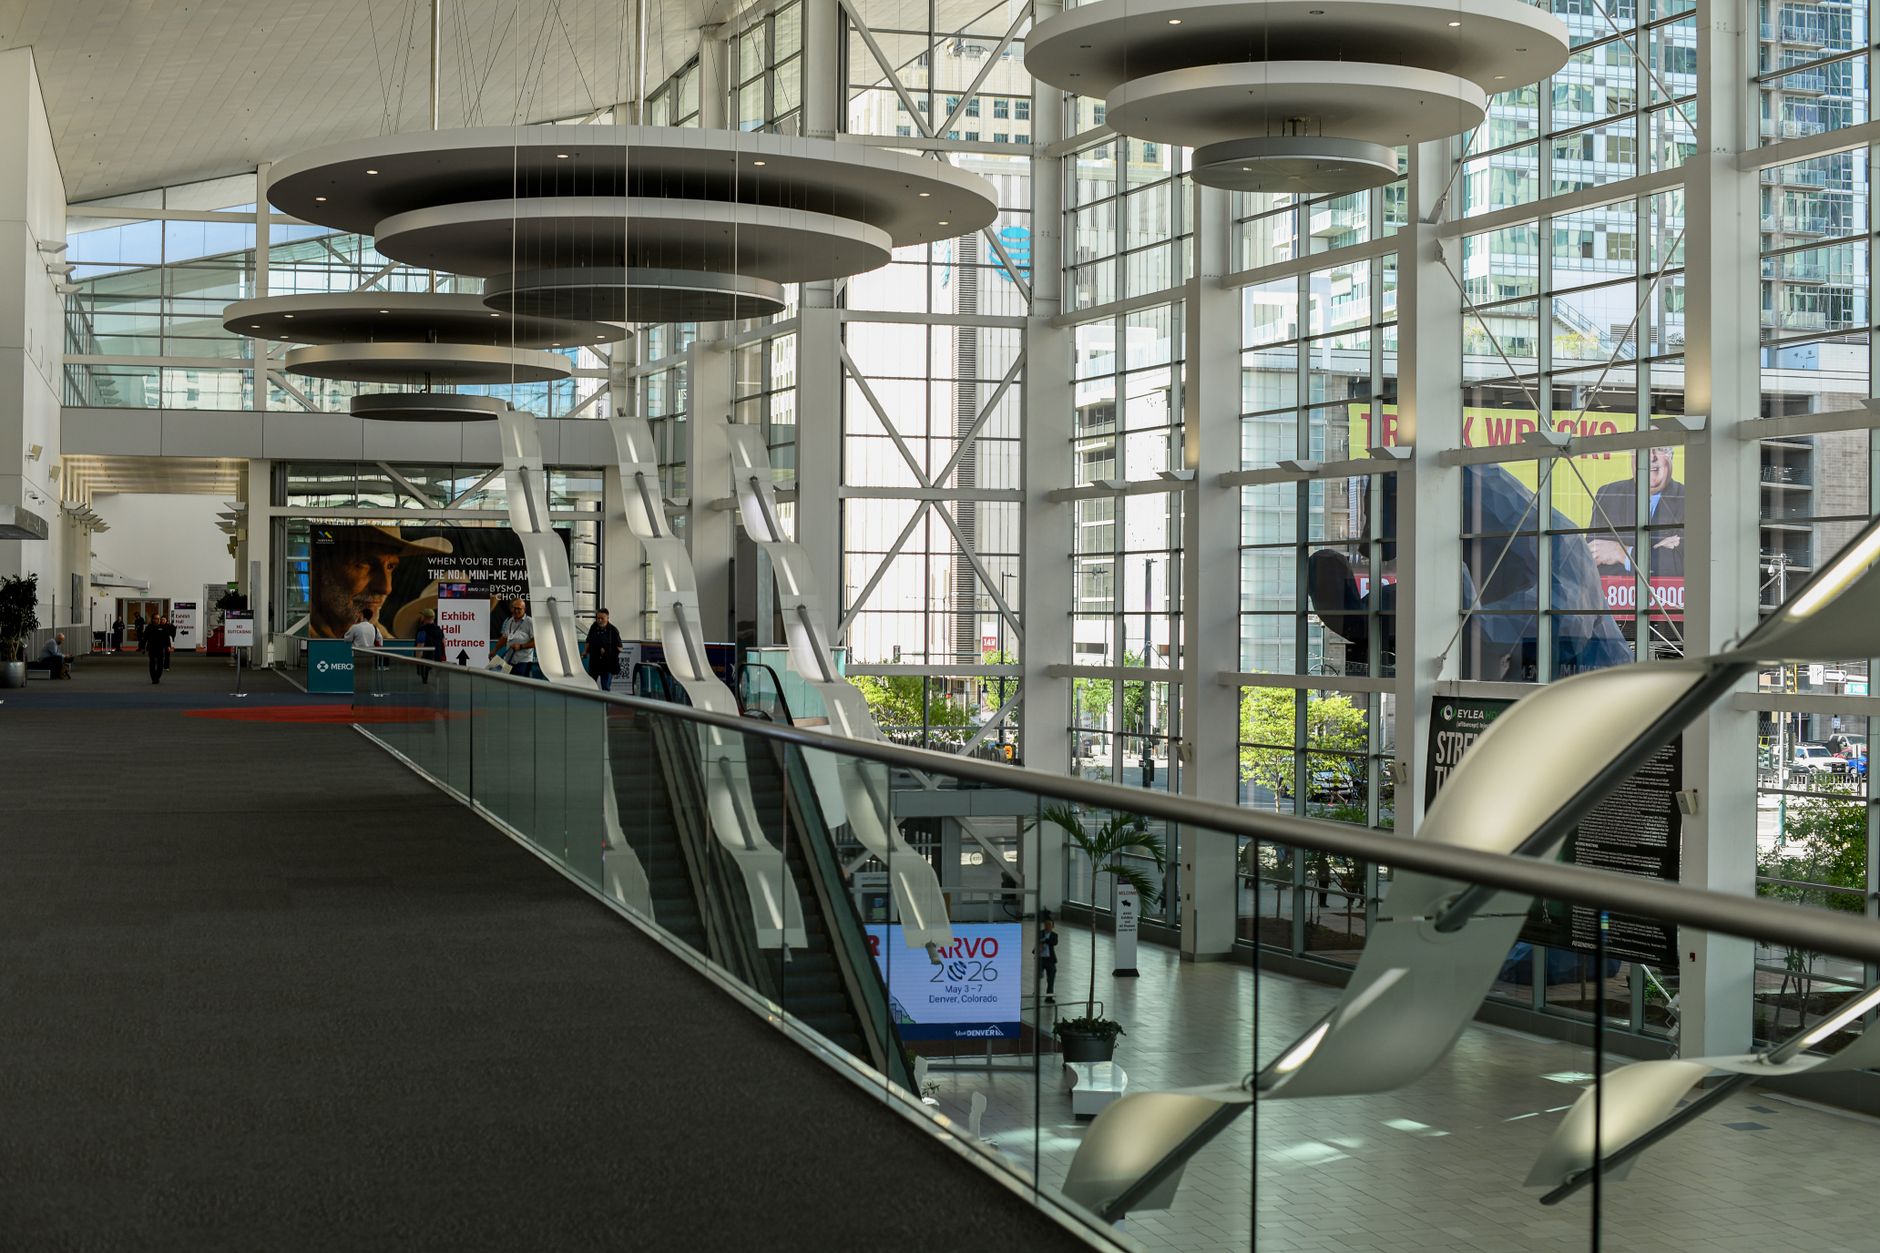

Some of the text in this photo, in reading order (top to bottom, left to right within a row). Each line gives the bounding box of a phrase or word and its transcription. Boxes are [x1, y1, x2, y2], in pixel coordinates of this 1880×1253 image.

[428, 557, 526, 566] WHEN YOU'RE TREAT
[428, 569, 529, 581] THE NO.1 MINI-ME MAK
[441, 612, 475, 621] Exhibit
[441, 625, 460, 634] Hall
[1457, 709, 1484, 719] EYLEA
[1436, 731, 1479, 764] STRE
[945, 985, 962, 995] May
[929, 994, 997, 1004] Denver, Colorado
[966, 1029, 994, 1037] DENVER
